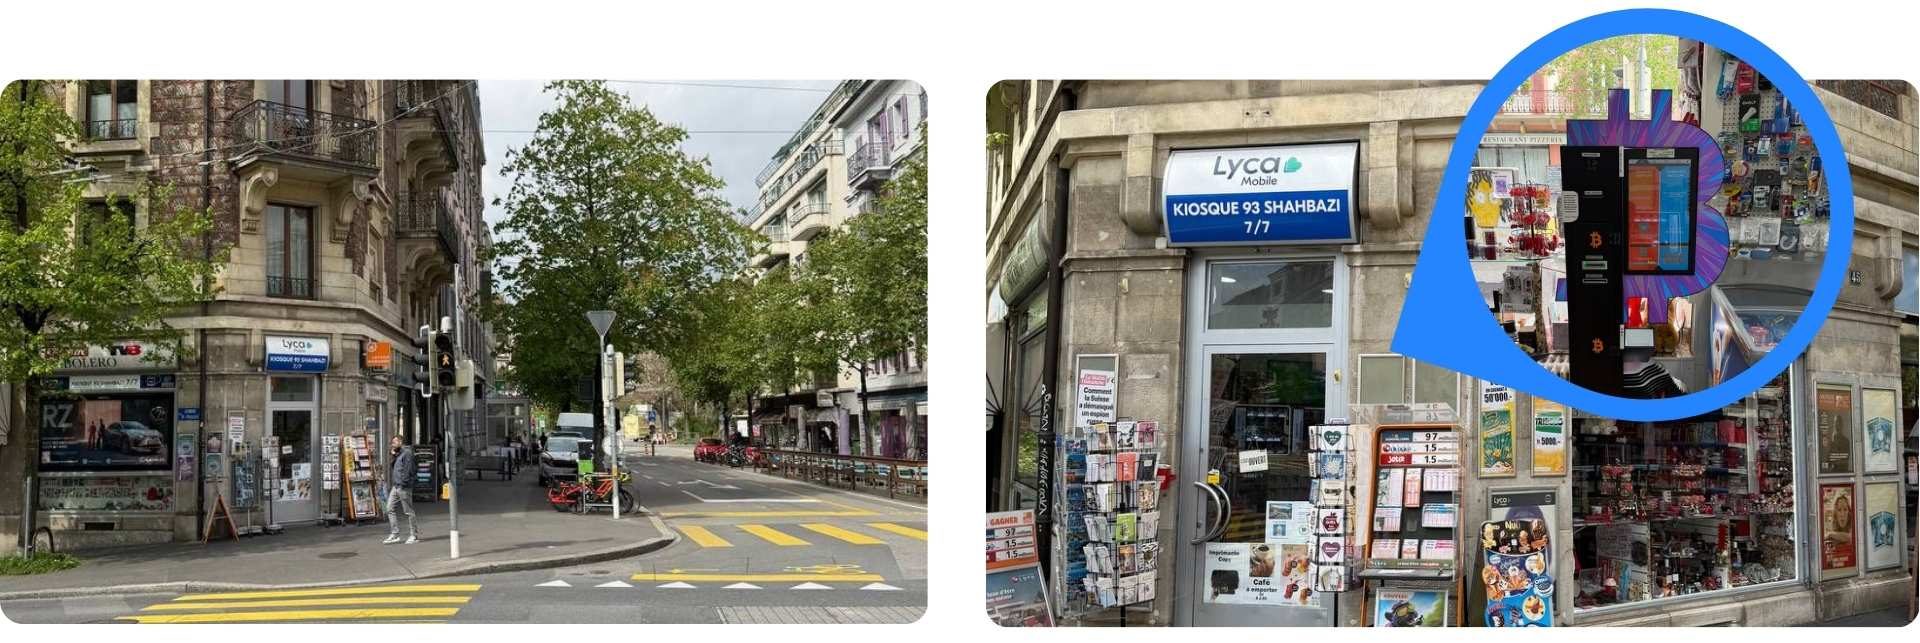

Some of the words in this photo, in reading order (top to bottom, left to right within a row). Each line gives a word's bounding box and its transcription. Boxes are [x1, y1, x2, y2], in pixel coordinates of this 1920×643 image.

[1529, 136, 1563, 144] PIZZERIA
[1214, 155, 1281, 179] Lyca
[1240, 176, 1278, 186] Mobile
[1173, 201, 1239, 216] KIOSQUE
[1242, 200, 1260, 214] 93
[1264, 198, 1340, 214] SHAHBAZI
[1244, 219, 1270, 235] 7/7
[282, 338, 306, 350] Lyca
[64, 357, 117, 369] BOLERO
[1083, 386, 1112, 394] Comment
[1091, 394, 1110, 402] Suisse
[42, 404, 73, 428] RZ
[1425, 432, 1438, 440] 97
[991, 516, 1018, 526] GAGNER
